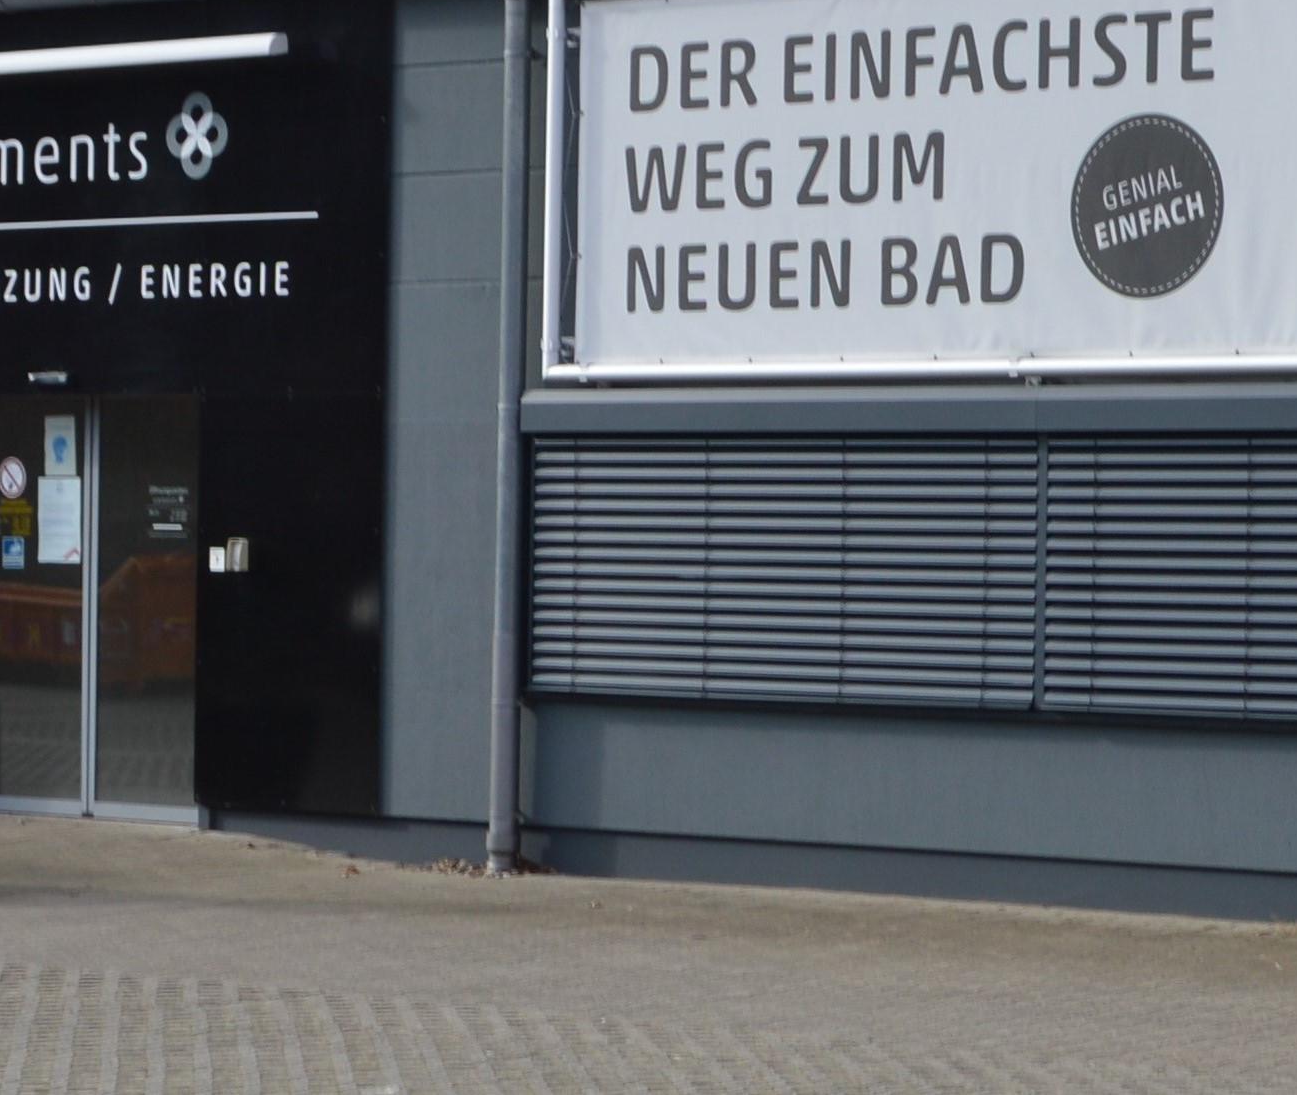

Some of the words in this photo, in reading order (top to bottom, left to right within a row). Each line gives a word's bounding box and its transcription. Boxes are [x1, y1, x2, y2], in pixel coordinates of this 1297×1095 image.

[629, 39, 758, 113] DER
[783, 8, 1216, 105] EINFACHSTE
[624, 139, 774, 214] WEG
[796, 130, 946, 206] ZUM
[1102, 164, 1183, 211] GENIAL
[1094, 190, 1206, 251] EINFACH
[139, 260, 291, 300] ENERGIE
[625, 239, 853, 314] NEUEN
[879, 234, 1026, 307] BAD
